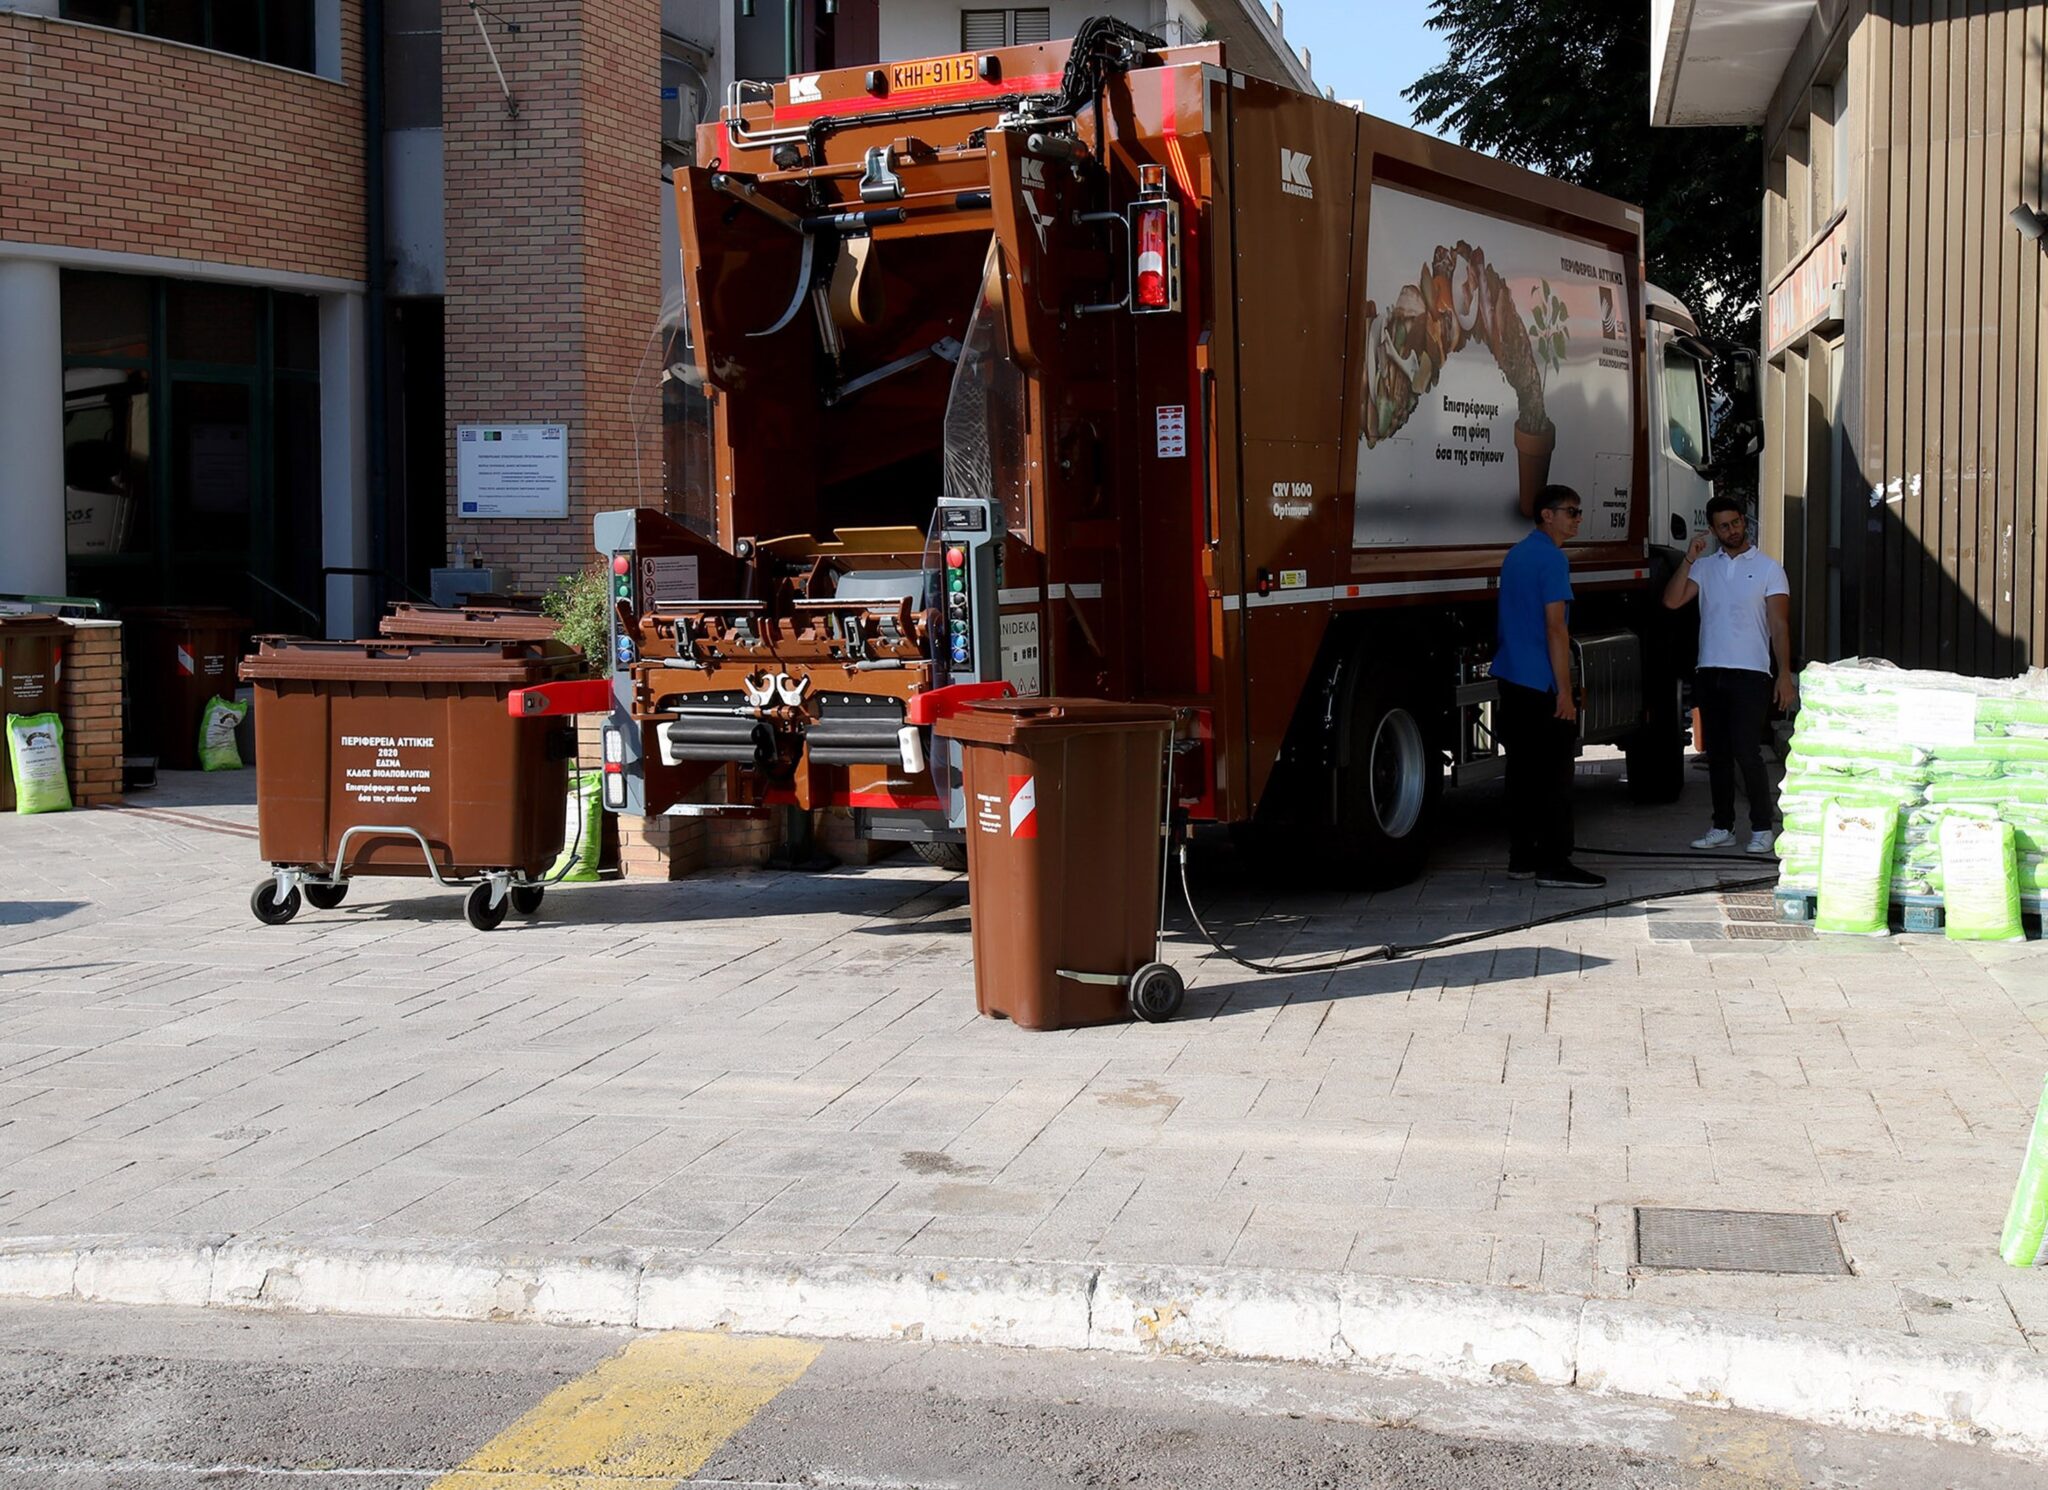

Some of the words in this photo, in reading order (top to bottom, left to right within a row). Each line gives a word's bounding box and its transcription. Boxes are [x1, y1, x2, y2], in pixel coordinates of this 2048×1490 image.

[894, 58, 974, 89] KHH-9115
[1443, 395, 1499, 420] Επιστρέφουμε
[1452, 425, 1467, 442] στη
[1468, 423, 1490, 443] φύση
[1435, 444, 1452, 460] όσα
[1454, 449, 1468, 466] της
[1470, 447, 1504, 466] ανήκουν
[1272, 482, 1289, 497] CRV
[1292, 482, 1312, 497] 1600
[1610, 512, 1626, 528] 1516
[341, 736, 396, 746] ΠΕΡΙΦΕΡΕΙΑ
[398, 737, 434, 748] ΑΤΤΙΚΗΣ
[378, 748, 398, 757] 2020
[346, 769, 372, 778] ΚΑΔΟΣ
[373, 770, 430, 778] ΒΙΟΑΠΟΒΛΗΤΩΝ
[346, 782, 395, 793] Επιστρέφουμε
